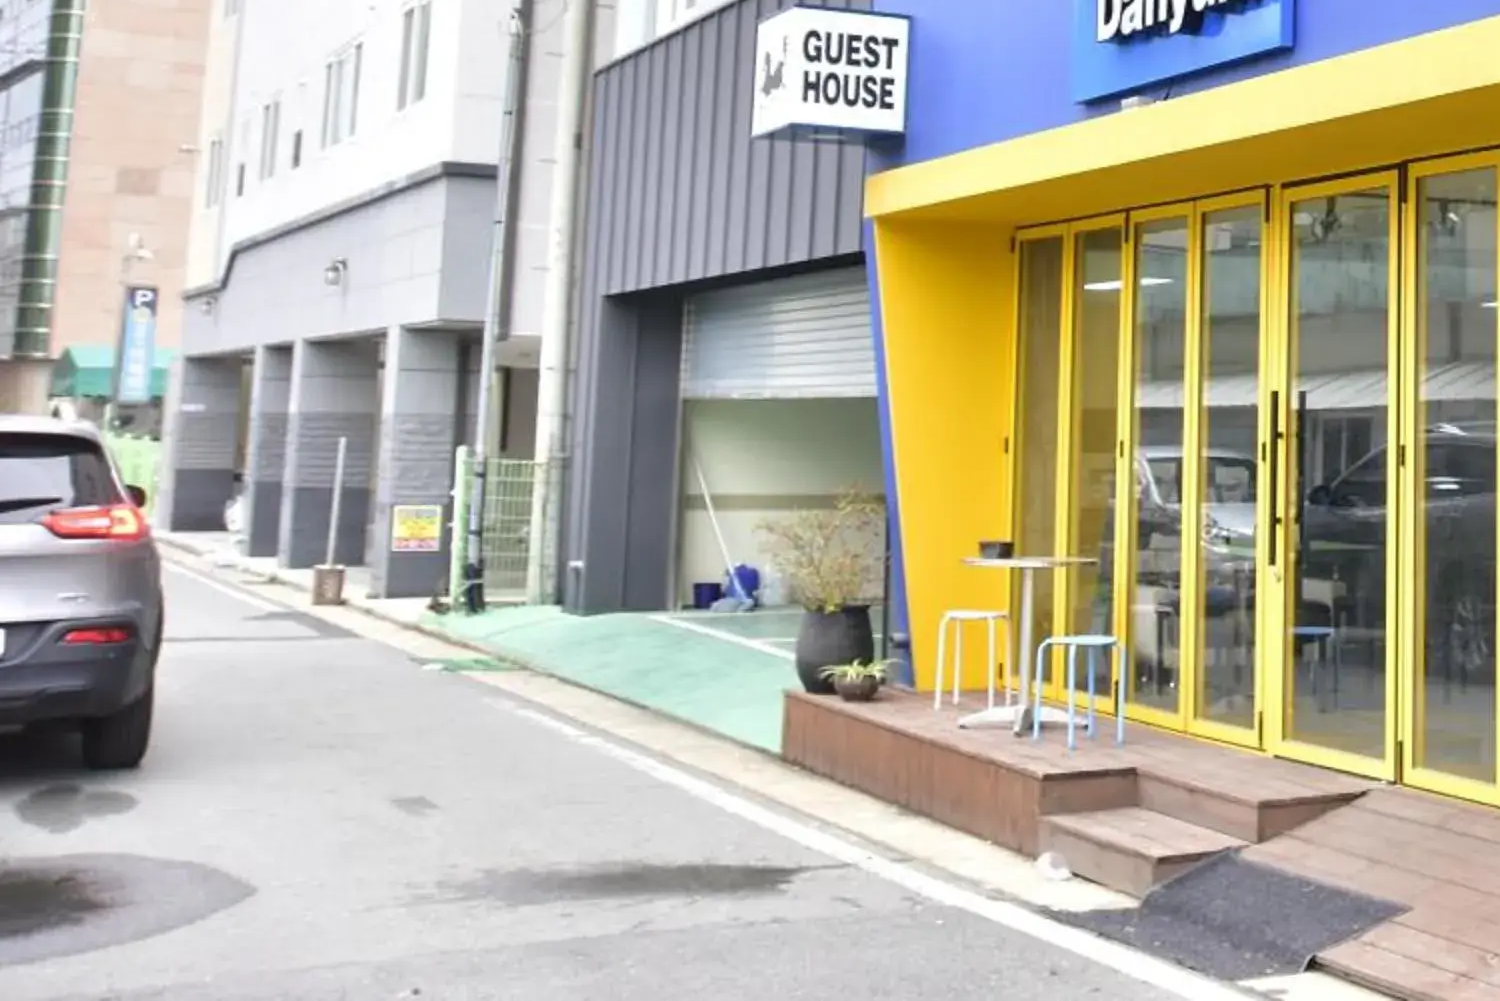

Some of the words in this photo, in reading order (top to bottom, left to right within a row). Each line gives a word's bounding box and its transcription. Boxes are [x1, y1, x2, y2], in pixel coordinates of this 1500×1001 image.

[802, 29, 899, 70] GUEST
[801, 70, 895, 110] HOUSE
[134, 289, 155, 308] P
